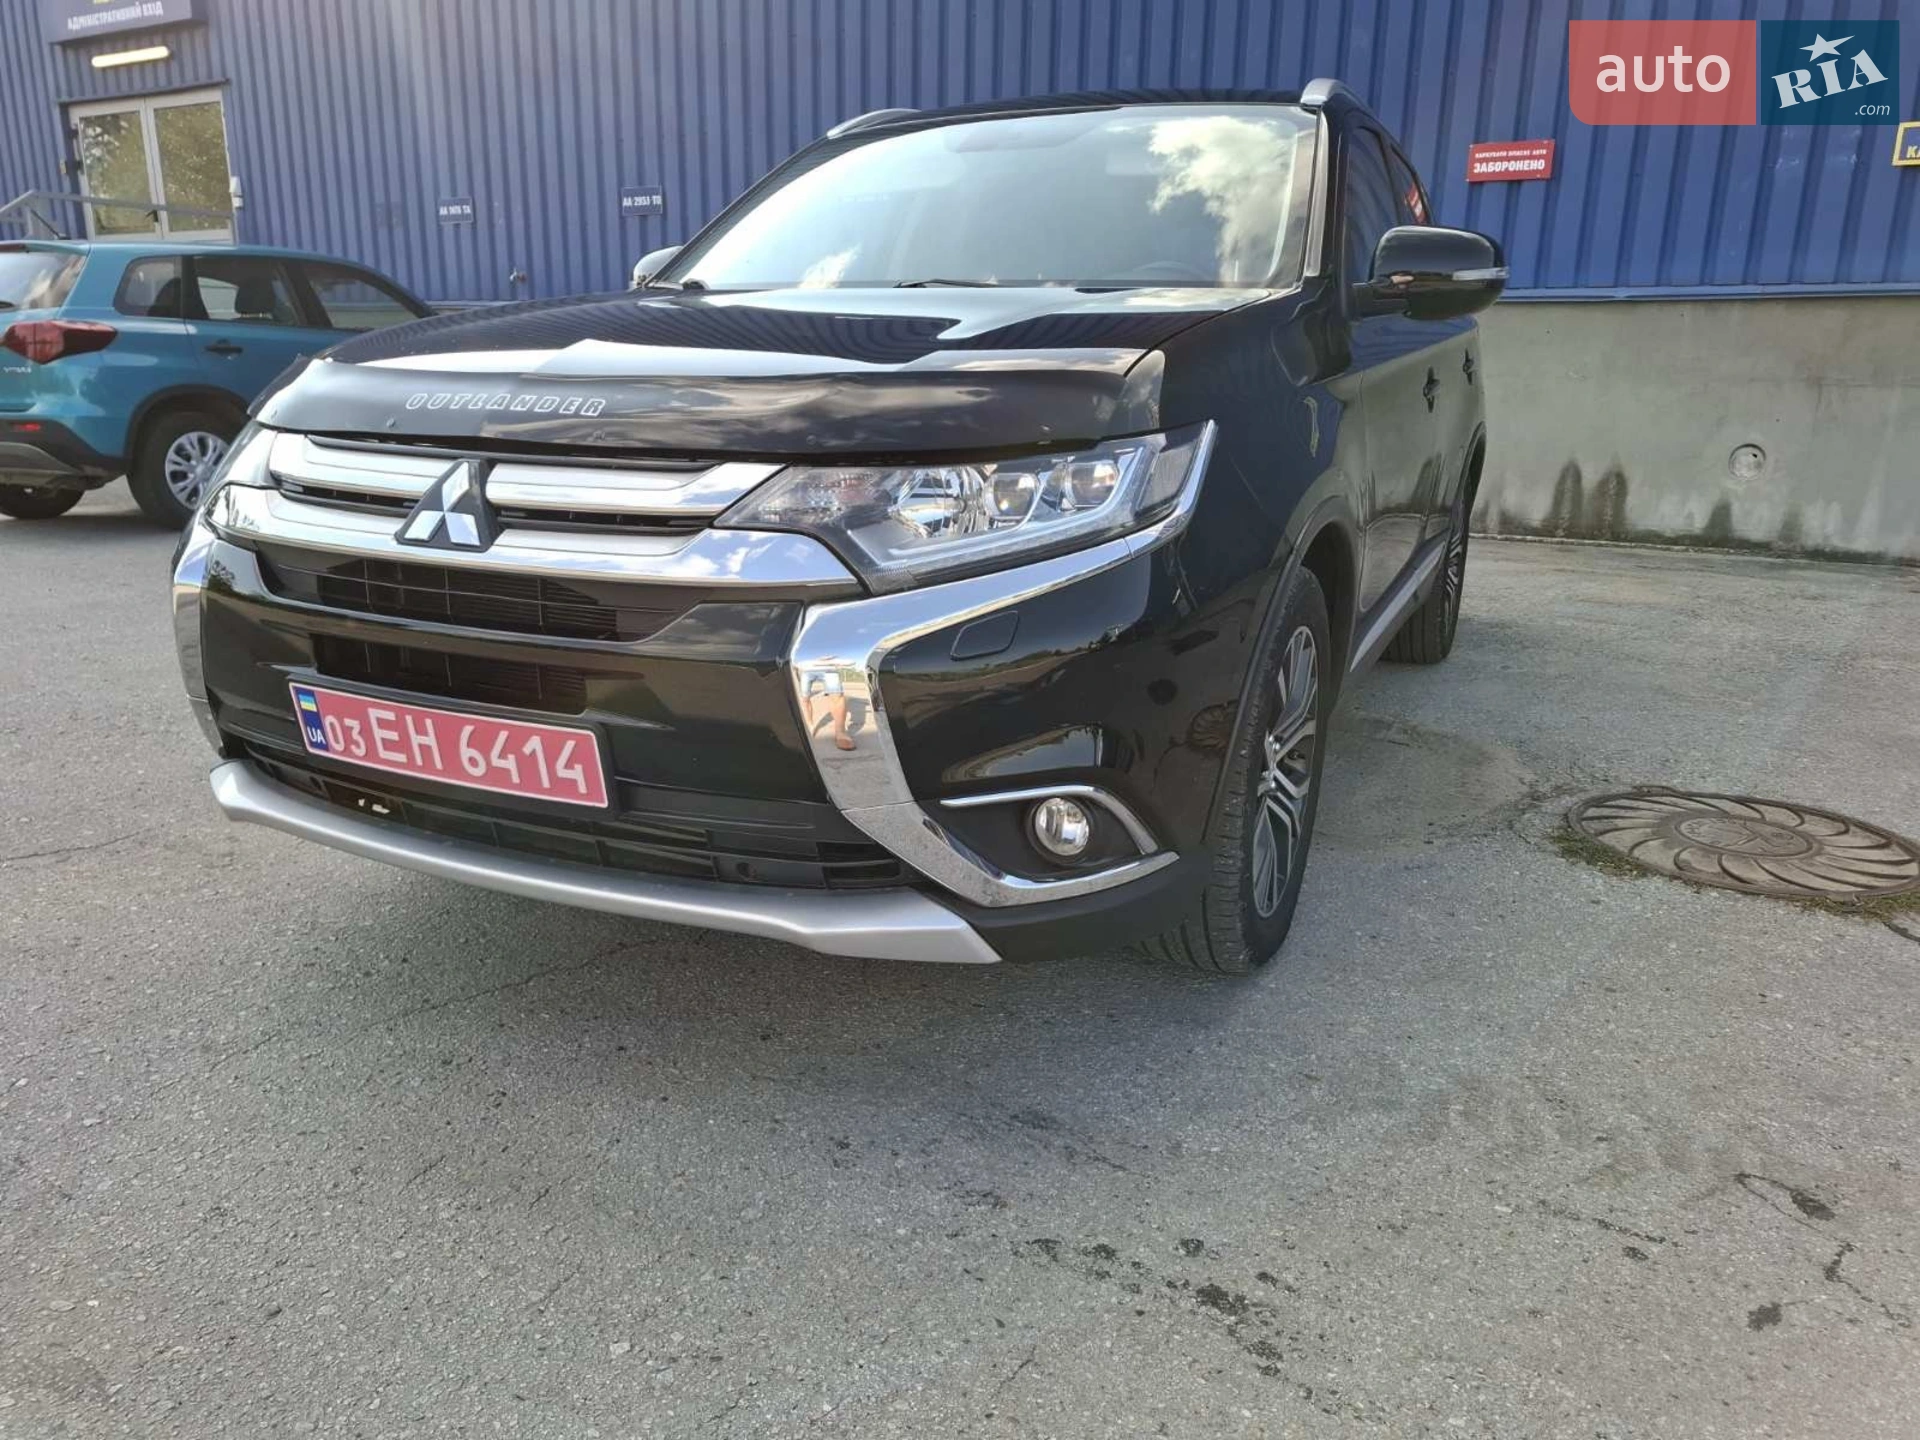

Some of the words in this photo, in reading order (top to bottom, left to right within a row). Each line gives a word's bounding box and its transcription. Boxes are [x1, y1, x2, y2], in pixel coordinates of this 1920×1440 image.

[1473, 159, 1545, 173] ЗАБОРОНЕНО
[406, 394, 606, 417] OUTLANDER
[308, 725, 325, 745] UA
[459, 725, 588, 794] 6414
